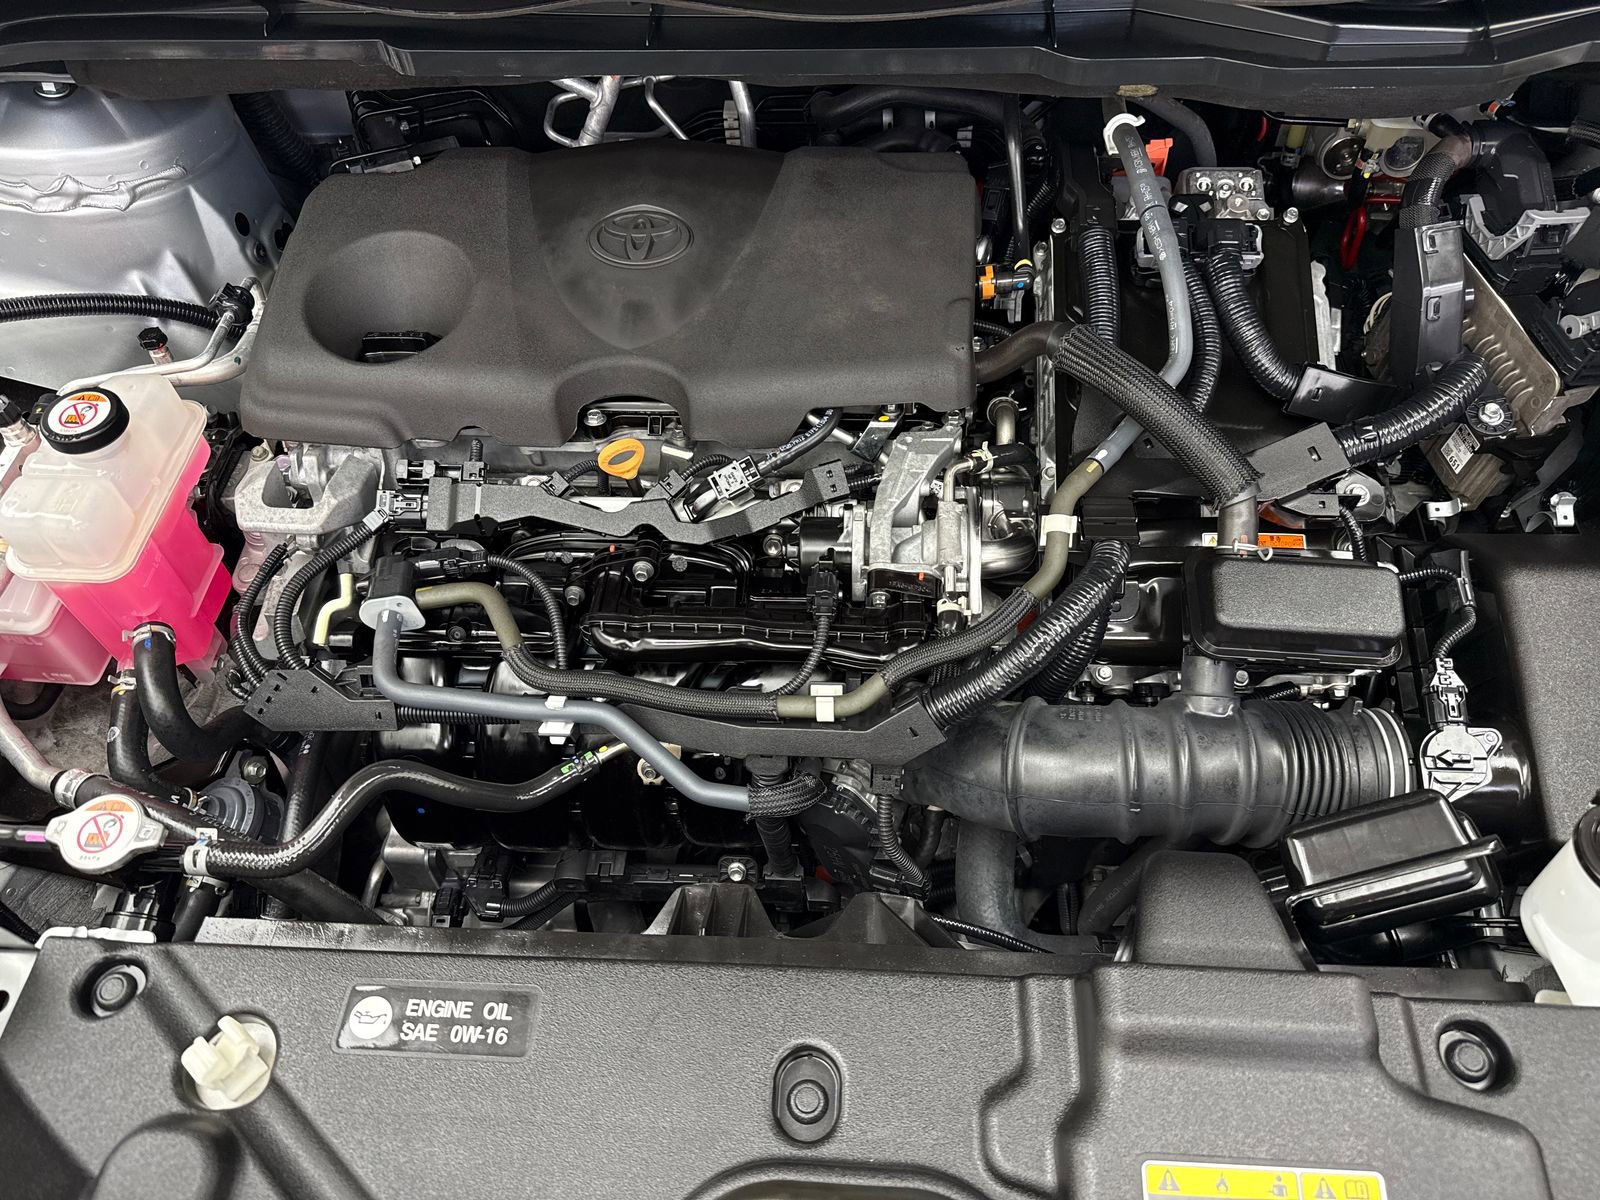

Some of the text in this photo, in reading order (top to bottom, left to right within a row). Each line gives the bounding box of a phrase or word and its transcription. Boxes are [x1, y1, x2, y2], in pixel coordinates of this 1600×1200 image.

[1448, 455, 1460, 470] 651
[405, 998, 513, 1021] ENGINE OIL
[400, 1022, 509, 1045] SAE 0W-16
